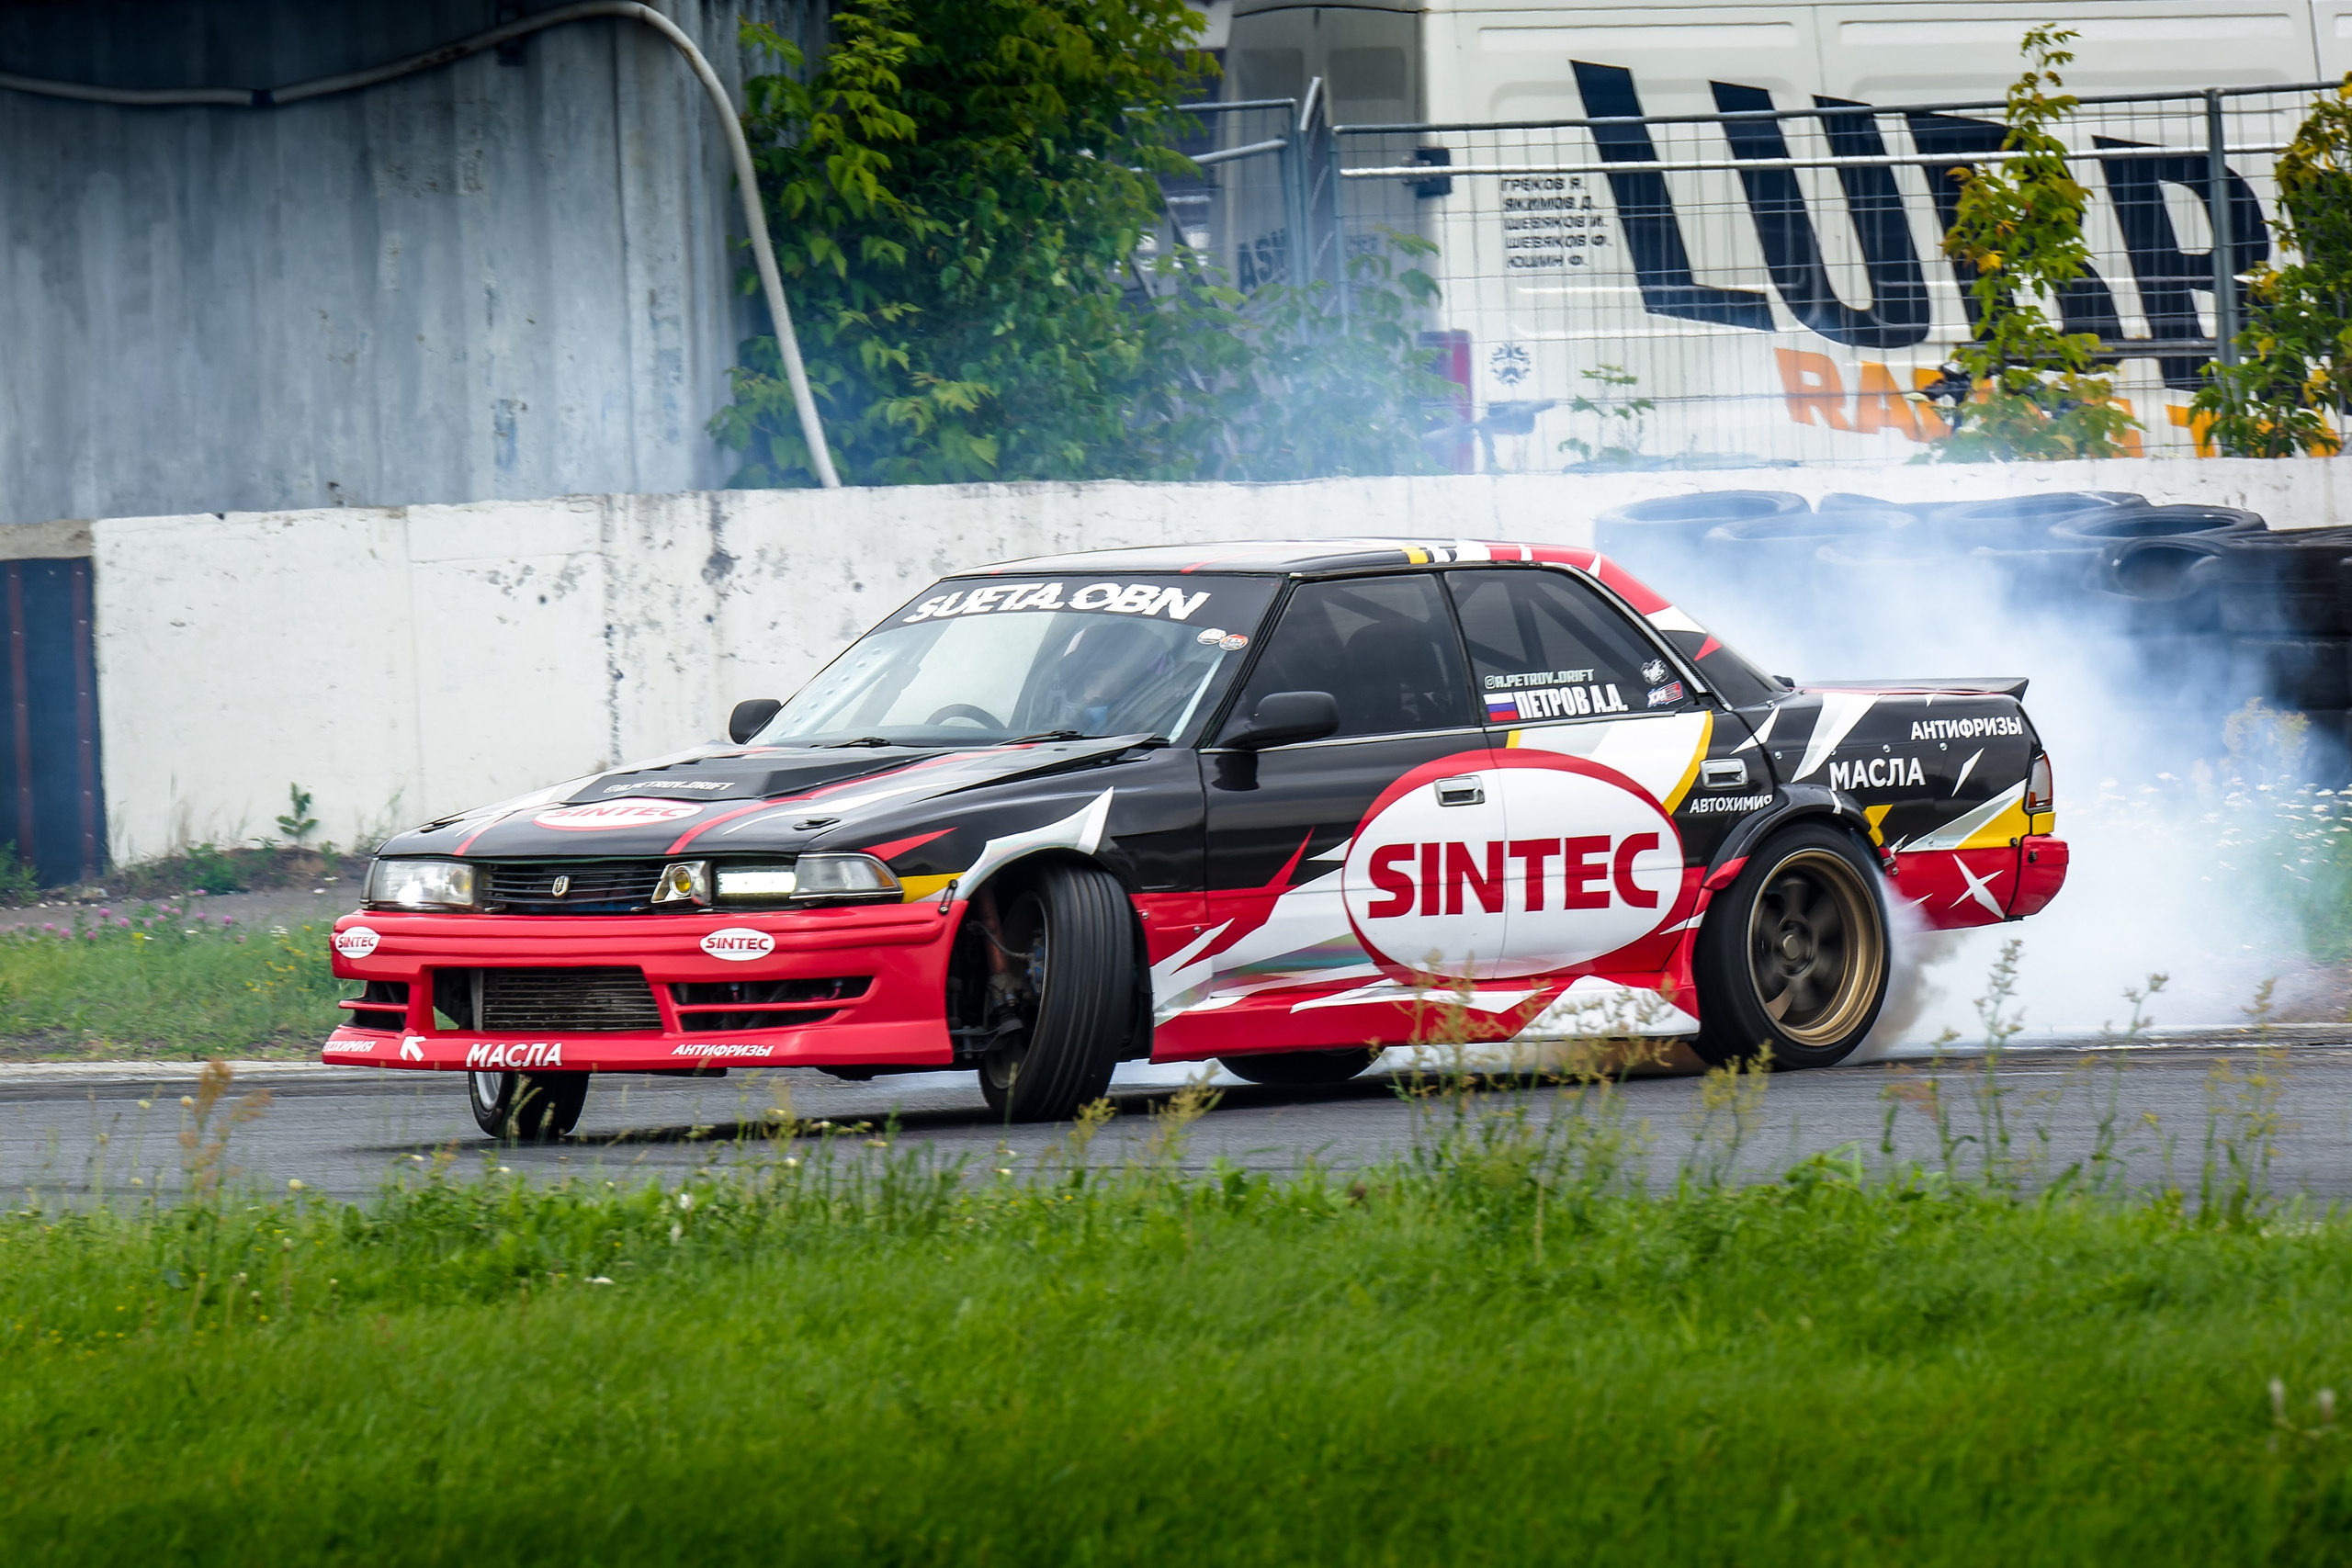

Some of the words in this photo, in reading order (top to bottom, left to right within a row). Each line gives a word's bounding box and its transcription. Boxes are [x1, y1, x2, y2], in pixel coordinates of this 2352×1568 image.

[1513, 686, 1588, 720] ПЕТРОВ
[1589, 683, 1629, 714] А.А.
[1910, 716, 2023, 741] АНТИФРИЗЫ
[1829, 757, 1927, 792] МАСЛА
[545, 807, 693, 819] SINTEC
[1367, 831, 1659, 919] SINTEC
[337, 936, 376, 949] SINTEC
[705, 937, 770, 951] SINTEC
[466, 1043, 563, 1068] МАСЛА
[672, 1043, 775, 1057] АНТИФРИЗЫ
